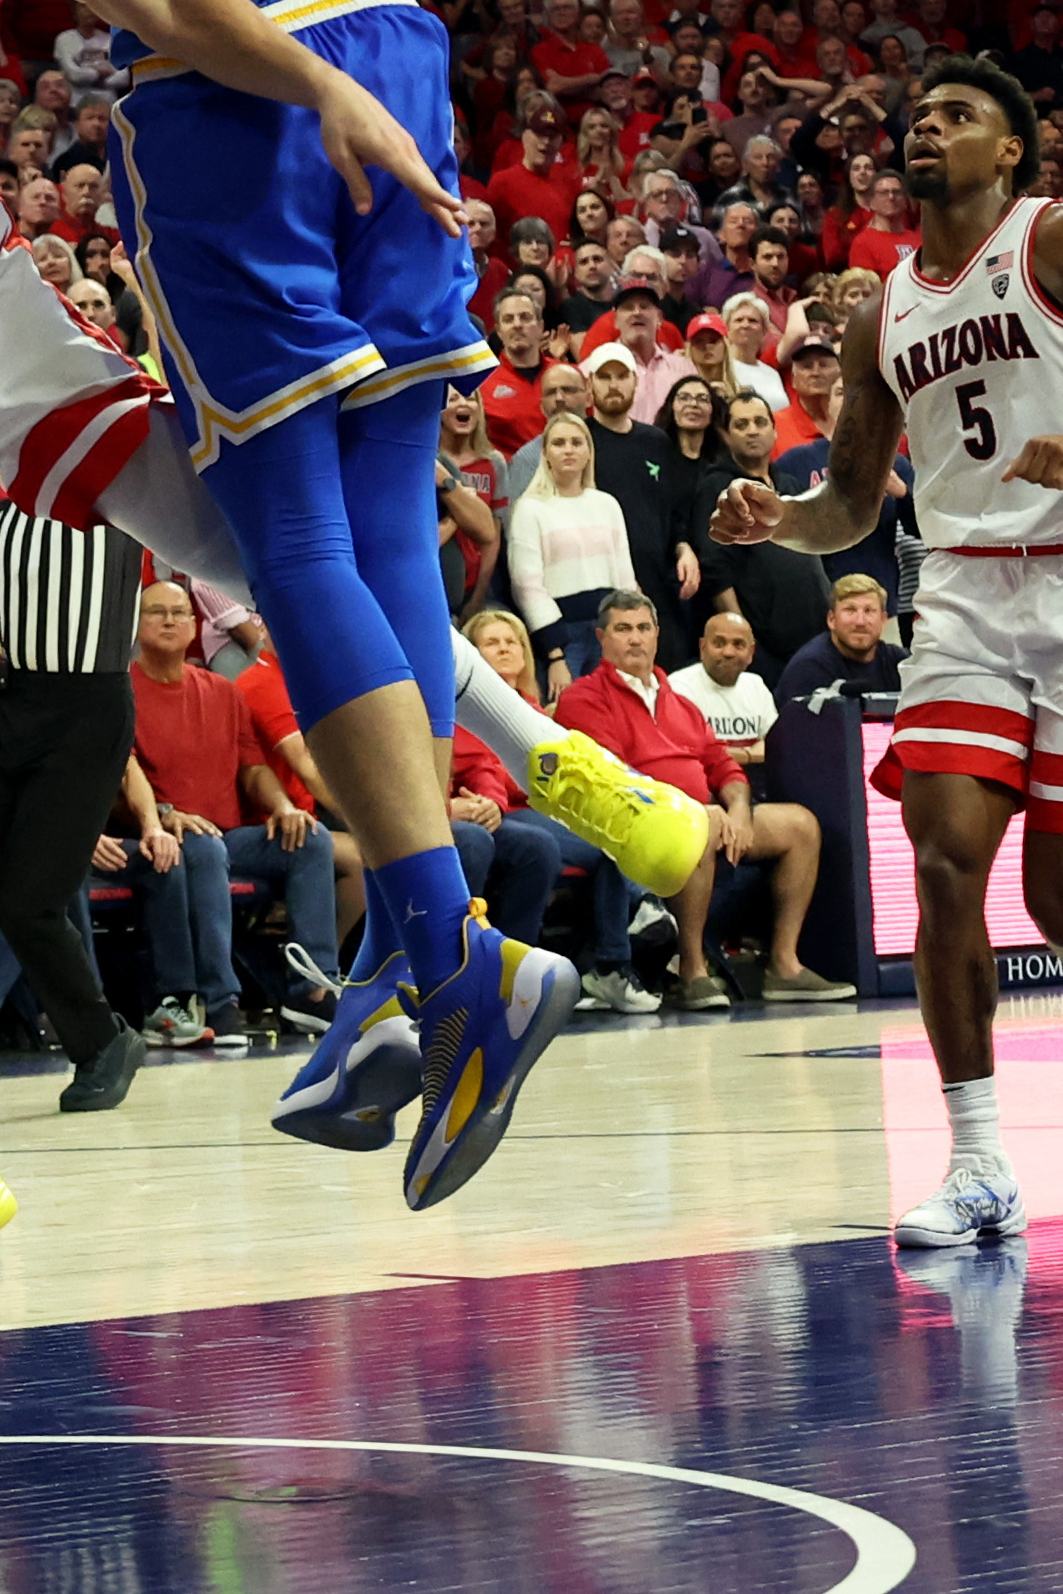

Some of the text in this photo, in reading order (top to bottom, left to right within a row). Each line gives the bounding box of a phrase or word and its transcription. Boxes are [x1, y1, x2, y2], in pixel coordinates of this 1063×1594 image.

[893, 312, 1041, 404] ARIZONA
[955, 379, 997, 461] 5
[1006, 954, 1063, 982] HOM
